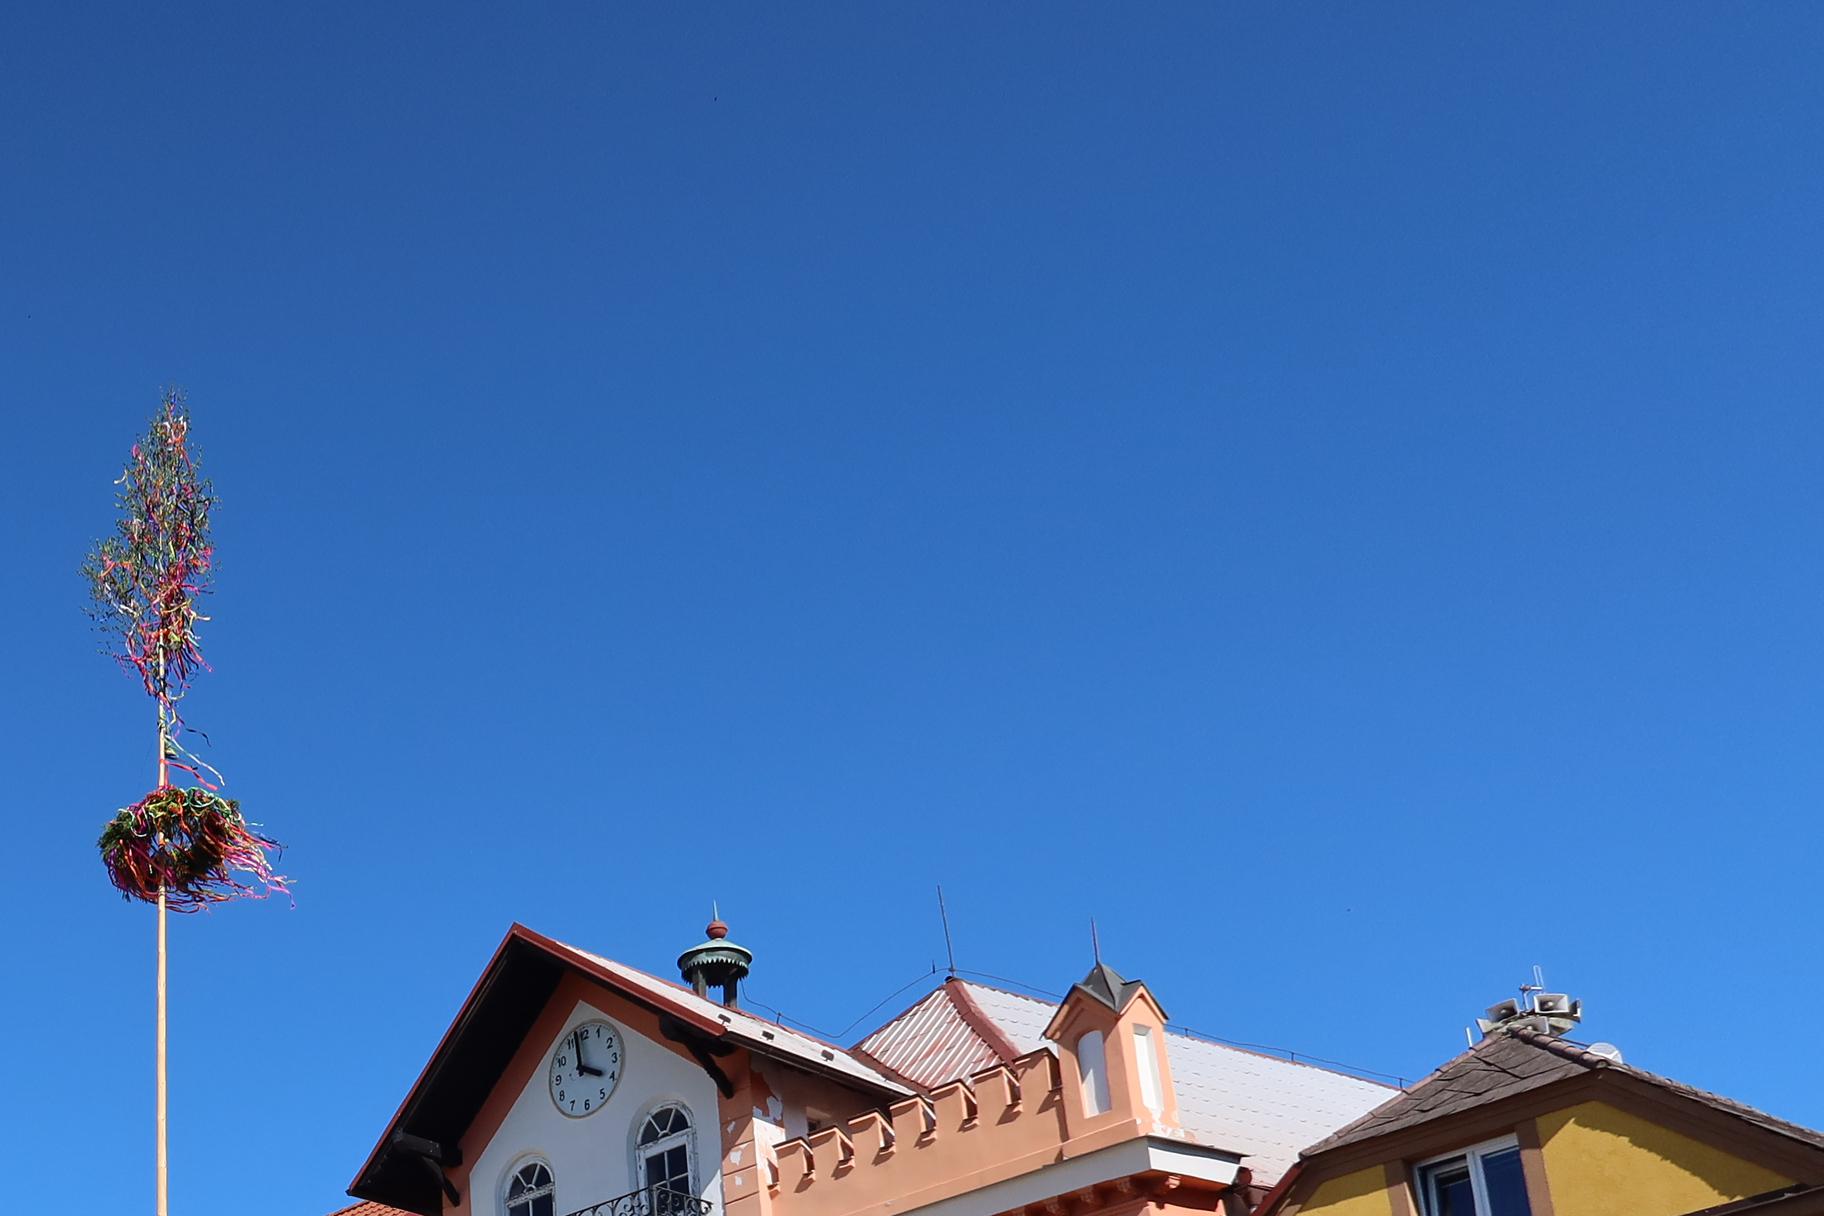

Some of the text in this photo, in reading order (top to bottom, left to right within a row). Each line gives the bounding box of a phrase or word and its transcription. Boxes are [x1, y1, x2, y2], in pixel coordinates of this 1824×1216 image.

[596, 1027, 601, 1038] 1
[567, 1039, 575, 1050] 11
[606, 1037, 613, 1049] 2
[557, 1056, 567, 1068] 10
[611, 1052, 618, 1063] 3
[556, 1075, 562, 1086] 9
[609, 1071, 615, 1082] 4
[559, 1090, 565, 1102] 8
[600, 1088, 606, 1100] 5
[570, 1099, 576, 1111] 7
[584, 1099, 591, 1111] 6
